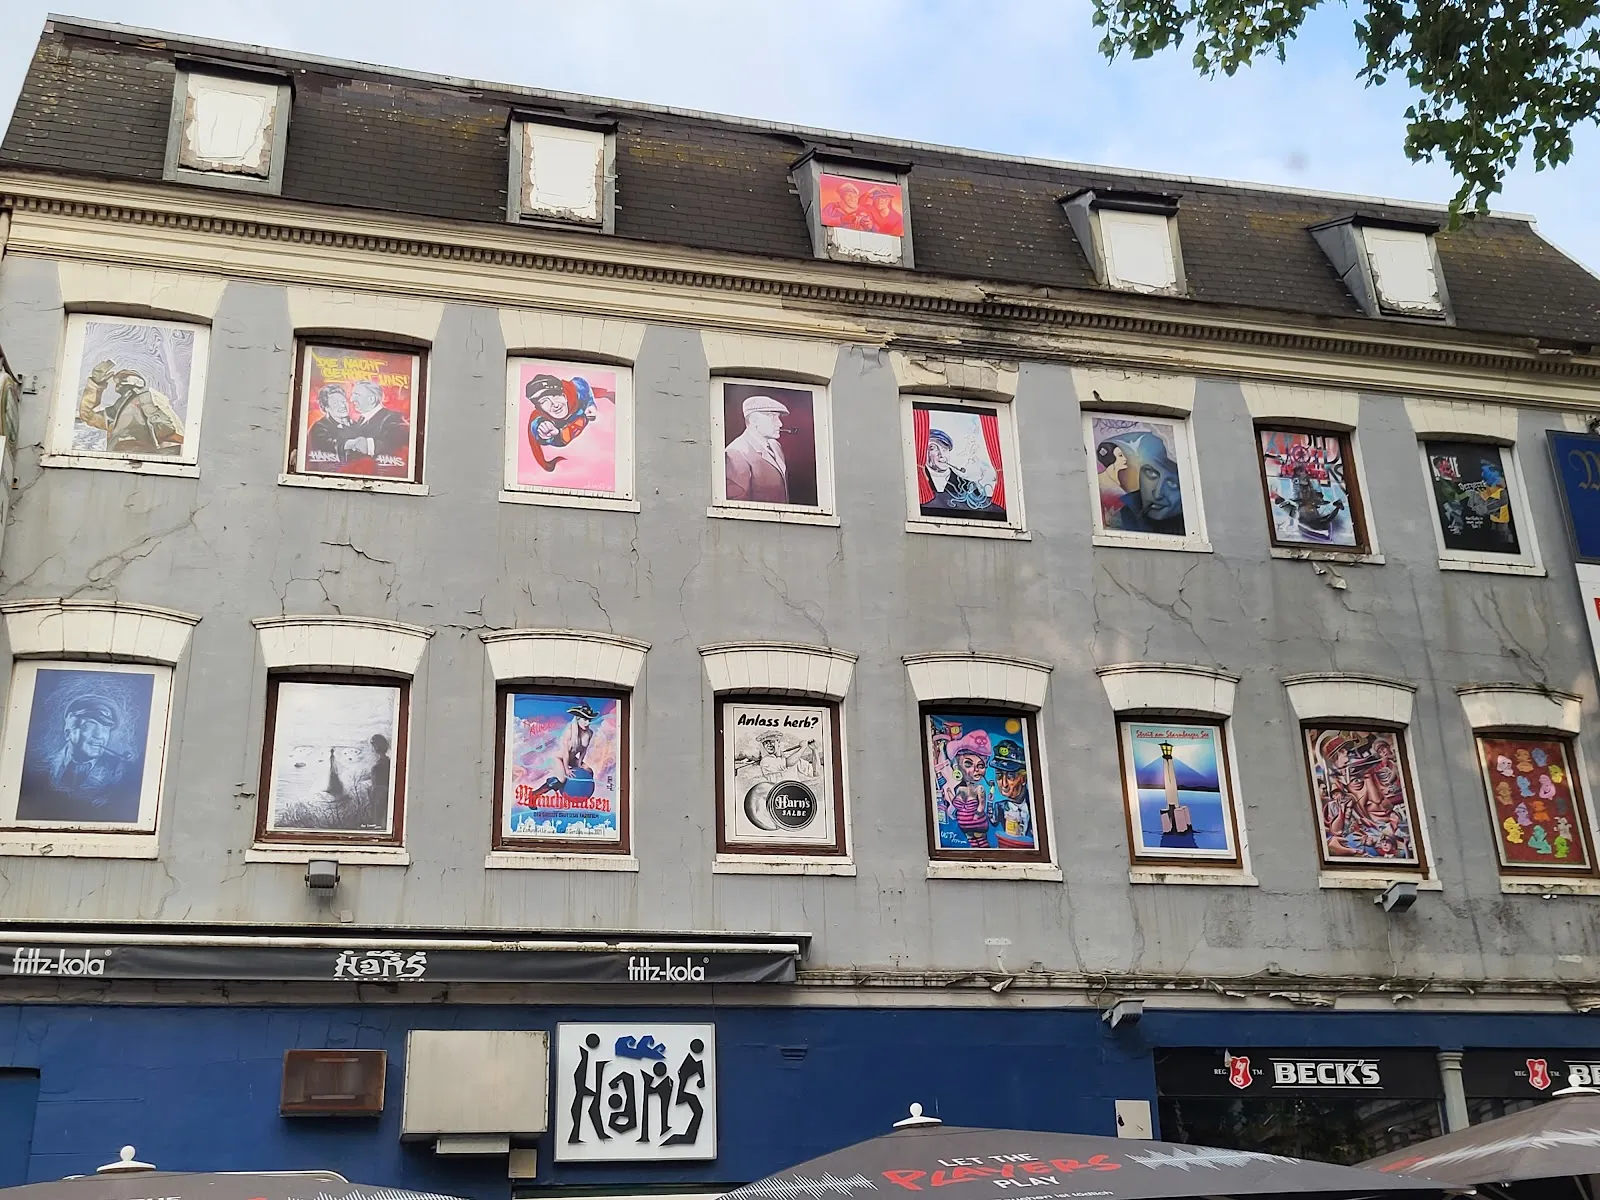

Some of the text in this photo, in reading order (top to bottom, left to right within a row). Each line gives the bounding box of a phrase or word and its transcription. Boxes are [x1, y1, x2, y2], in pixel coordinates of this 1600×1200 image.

[343, 357, 388, 372] NACHT
[378, 374, 409, 389] UNS!
[376, 455, 405, 467] HANS
[737, 714, 819, 729] Anlass herb?
[781, 809, 807, 817] SALBE
[1273, 1060, 1381, 1085] BECK'S
[937, 1153, 1038, 1167] LET THE
[882, 1153, 1122, 1191] PLAYERS
[992, 1176, 1060, 1189] PLAY
